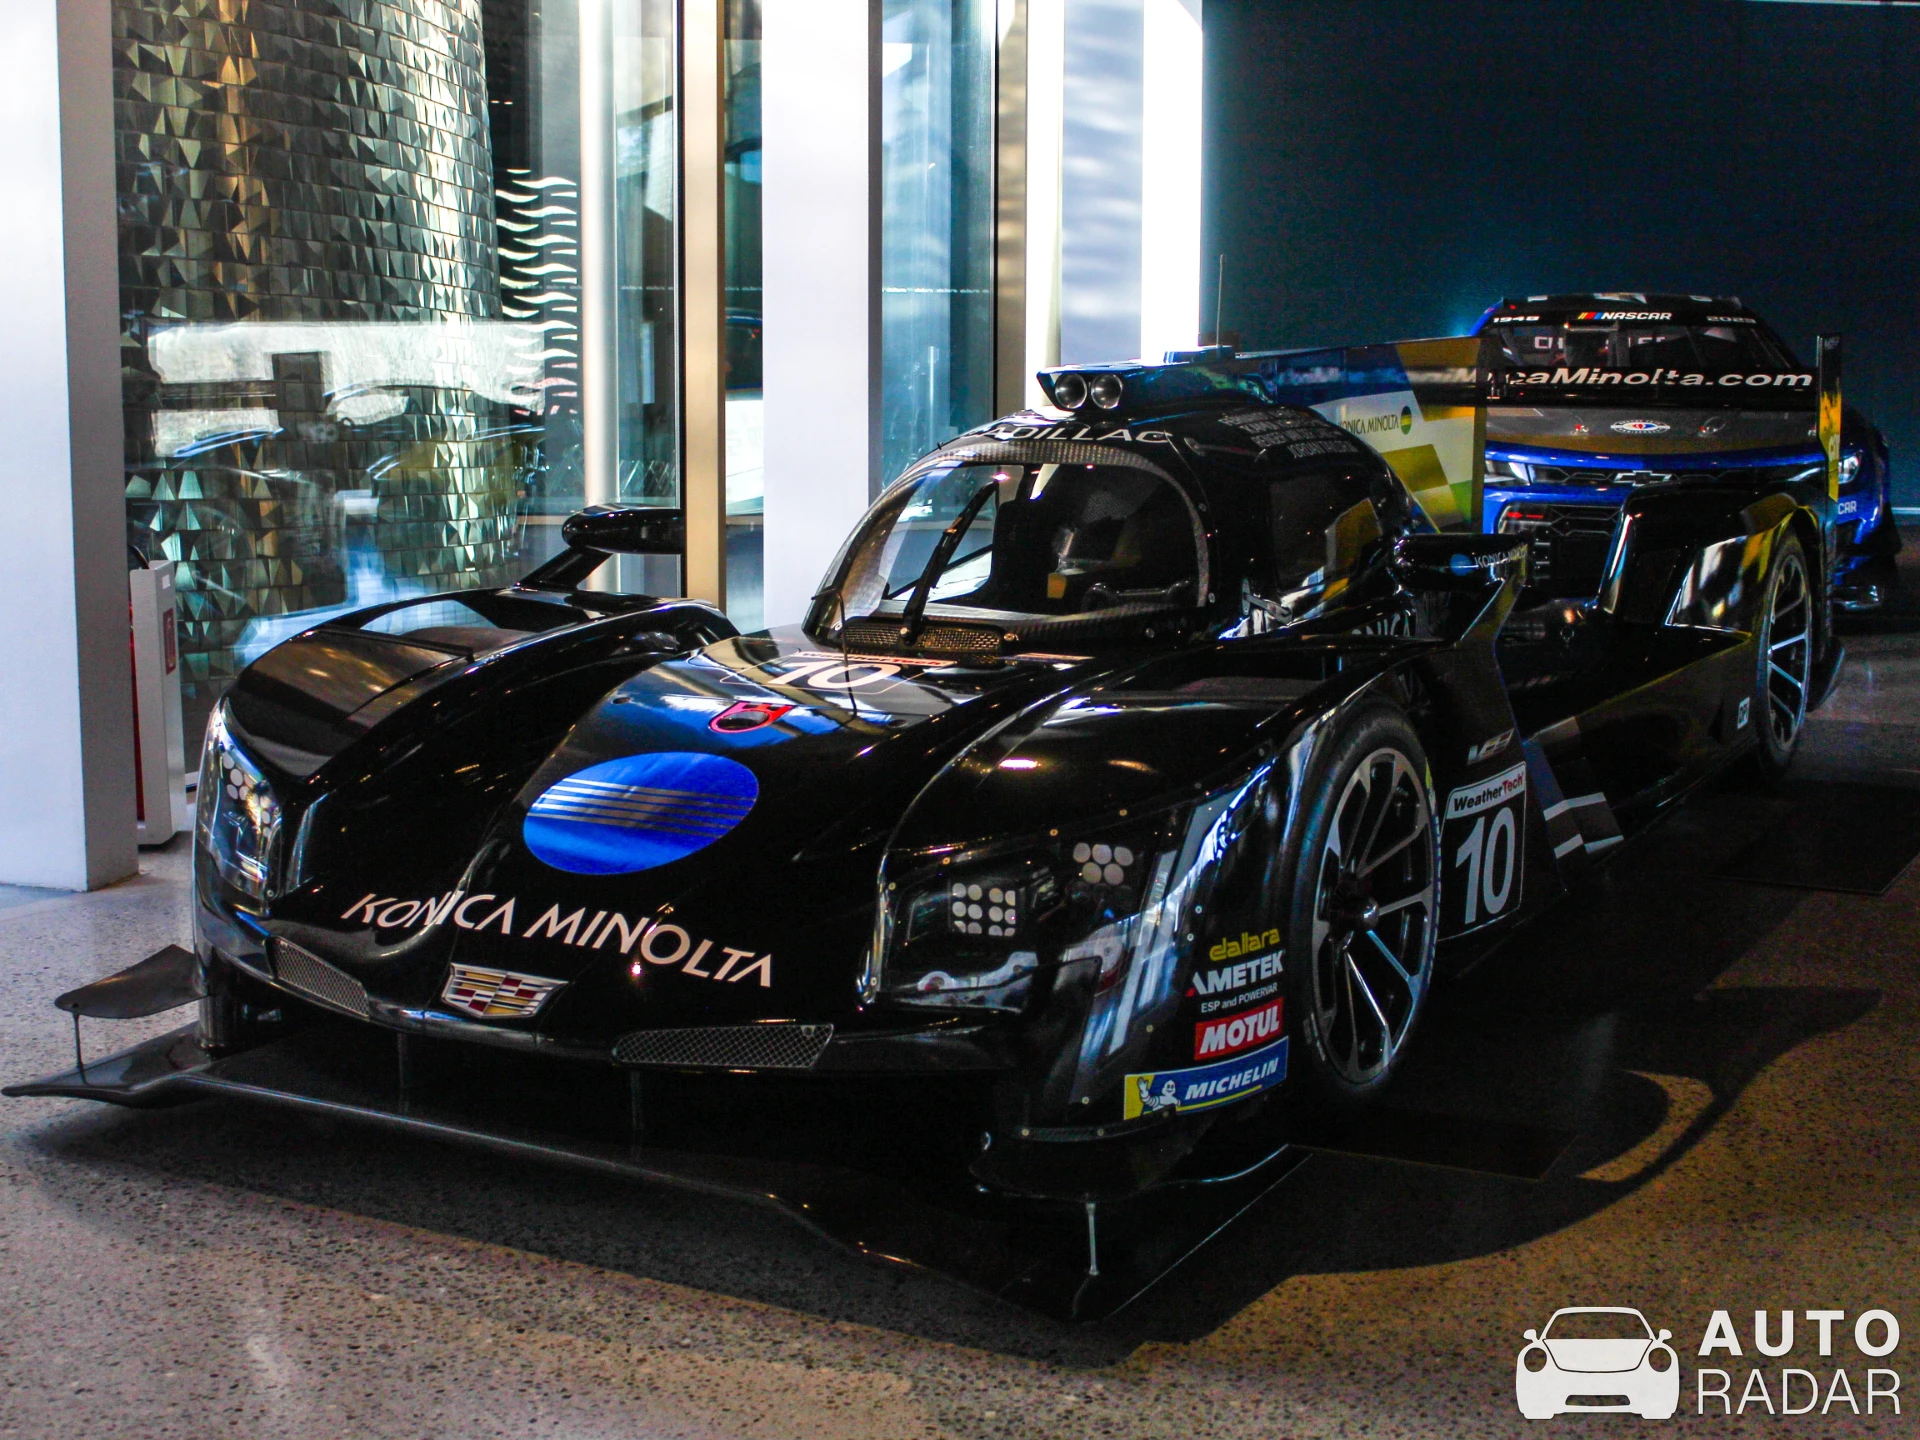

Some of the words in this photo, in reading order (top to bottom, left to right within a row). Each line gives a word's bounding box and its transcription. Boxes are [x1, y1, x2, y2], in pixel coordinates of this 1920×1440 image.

[1601, 312, 1673, 321] NASCAR
[766, 660, 902, 690] 10
[1453, 773, 1524, 812] WeatherTech
[1455, 806, 1516, 925] 10
[340, 890, 517, 935] KONICA
[523, 903, 772, 988] MINOLTA
[1209, 928, 1281, 962] dallara
[1201, 1002, 1221, 1014] ESP
[1222, 996, 1237, 1010] and
[1238, 982, 1279, 1005] POWERVAR
[1199, 1006, 1280, 1055] MOTUL
[1185, 1057, 1280, 1101] MICHELIN
